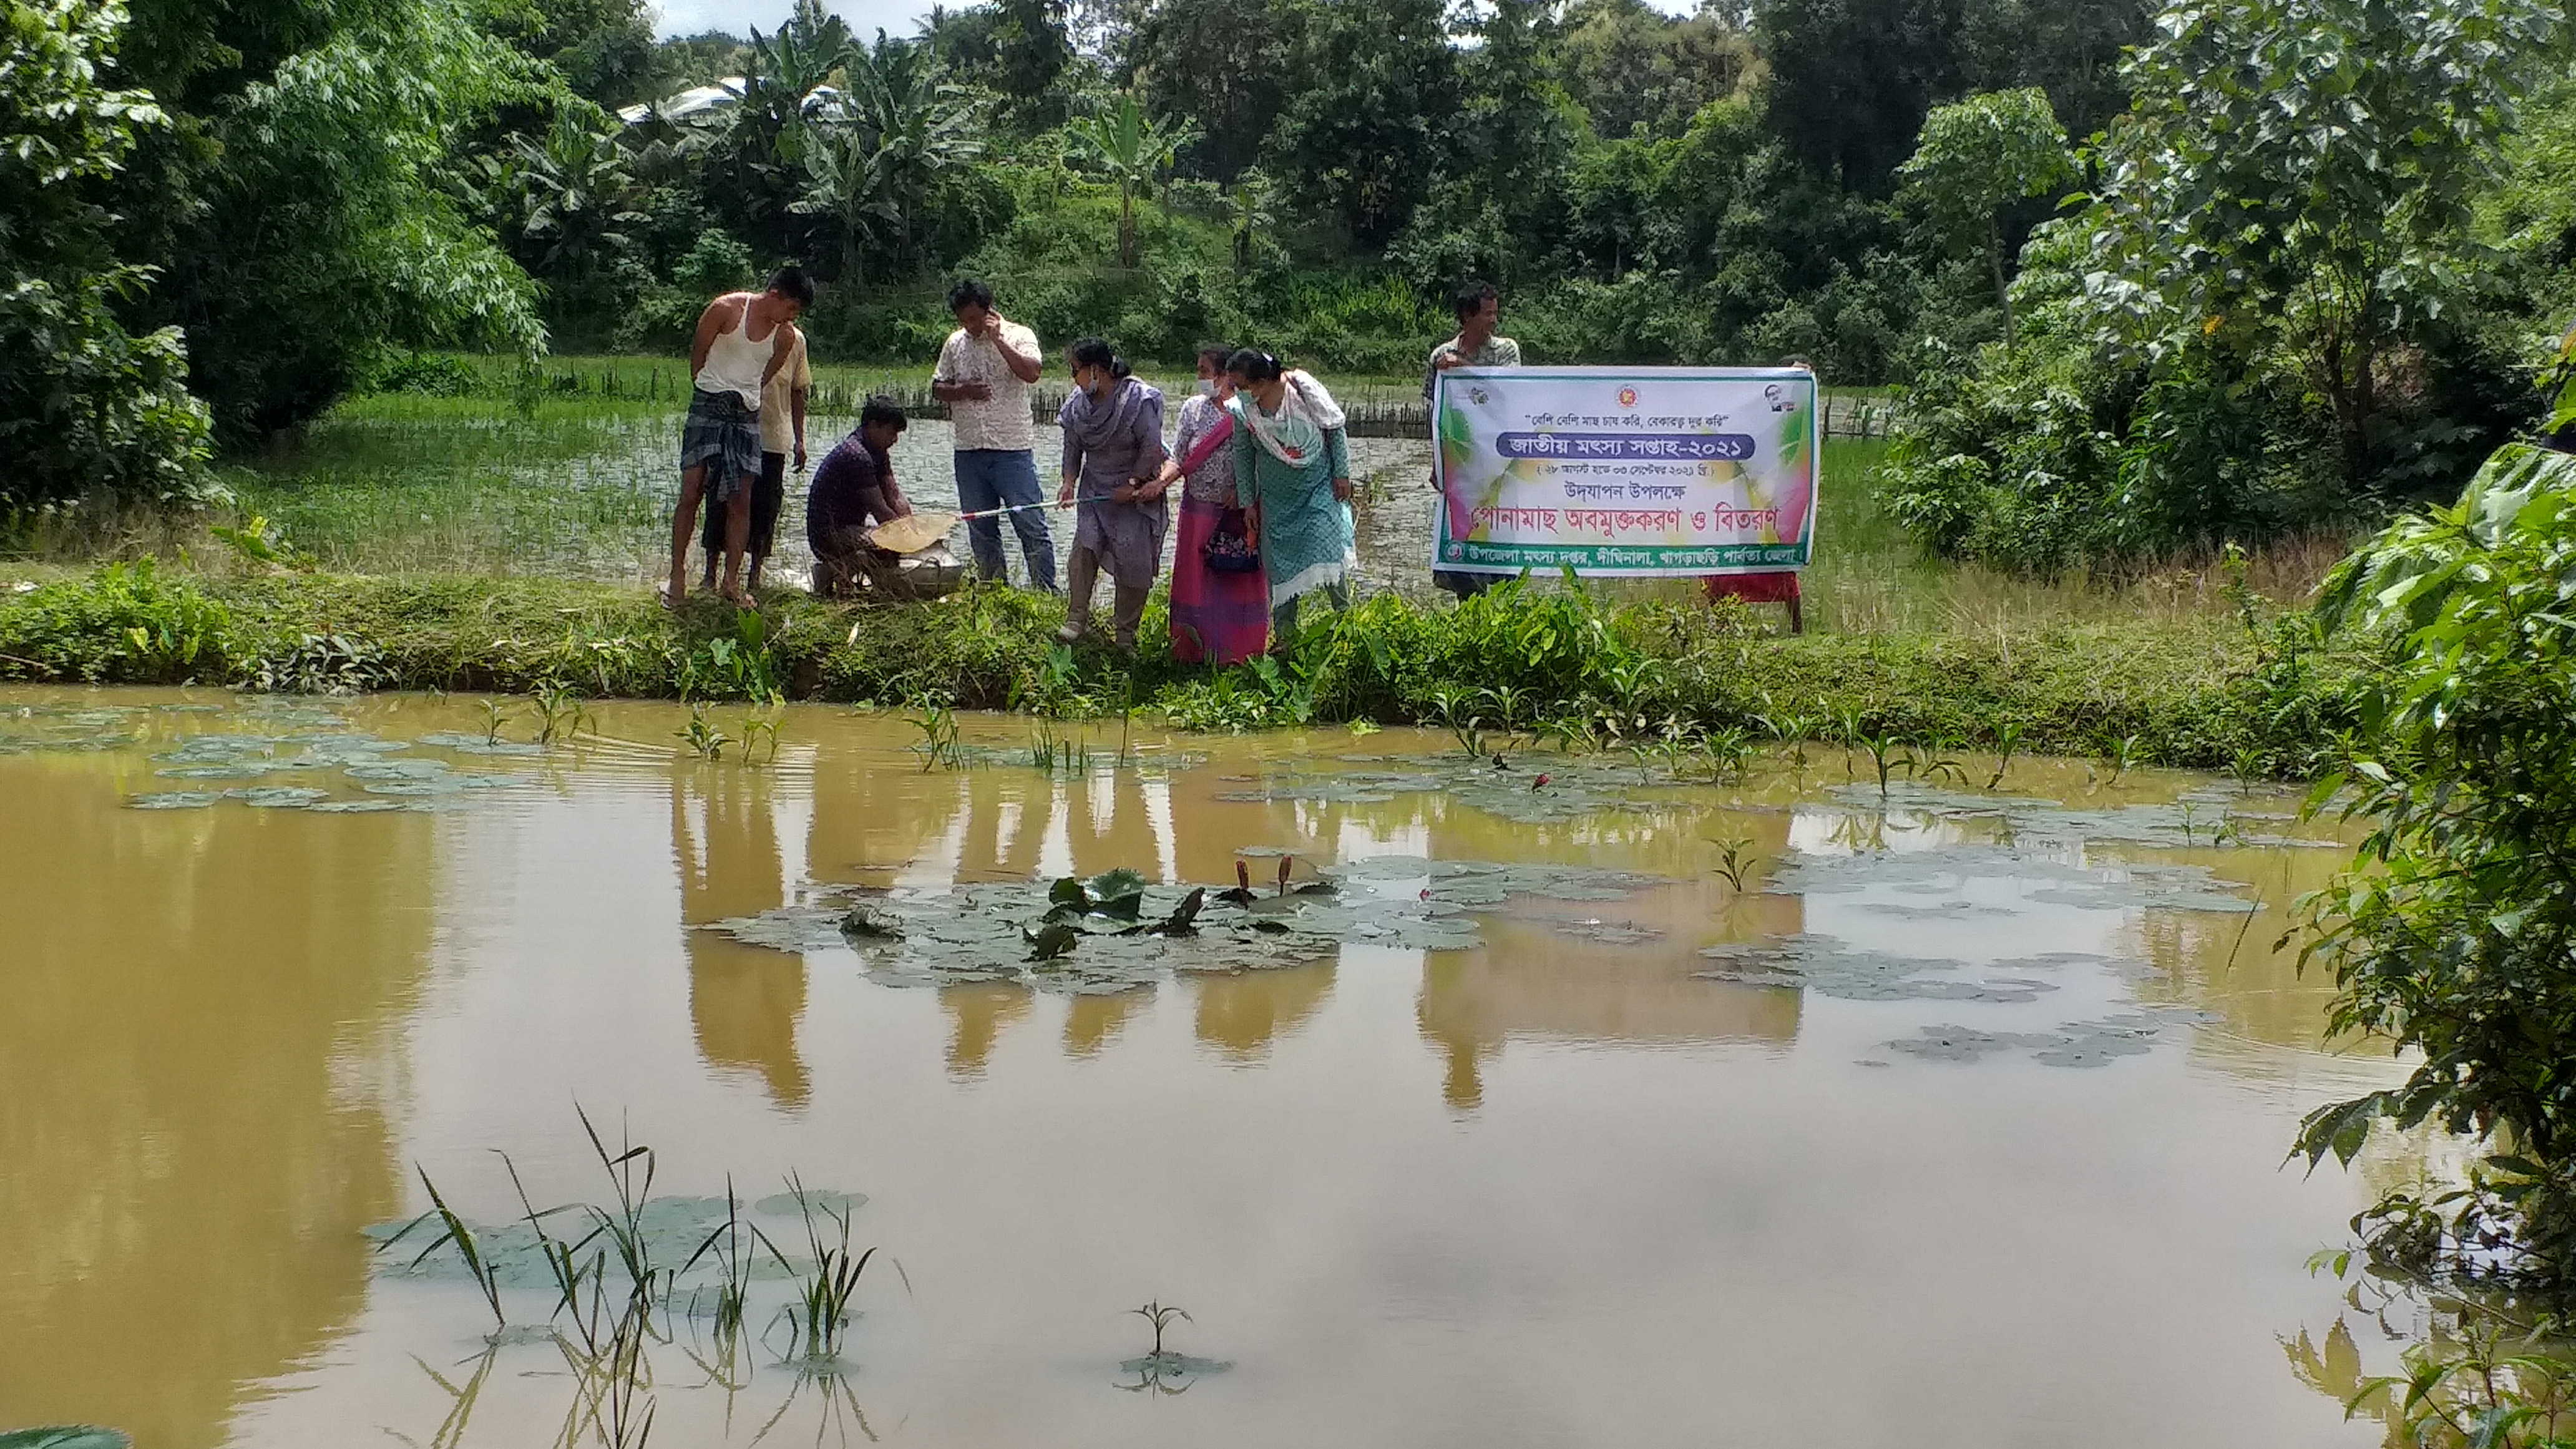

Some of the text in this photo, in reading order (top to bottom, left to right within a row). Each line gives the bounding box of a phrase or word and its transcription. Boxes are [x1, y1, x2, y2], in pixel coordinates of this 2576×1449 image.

[1621, 414, 1644, 429] করি,
[1508, 434, 1742, 458] জাতীয় মৎস্য সপ্তাহ-২০২১
[1669, 466, 1694, 476] ২০২১
[1629, 481, 1686, 500] উপলক্ষে
[1471, 501, 1782, 539] পোনামাছ অবমুক্তকরণ ও বিতরণ
[1469, 545, 1520, 563] উপজেলা
[1523, 550, 1556, 565] মৎস্য
[1724, 546, 1761, 564] পার্বত্য
